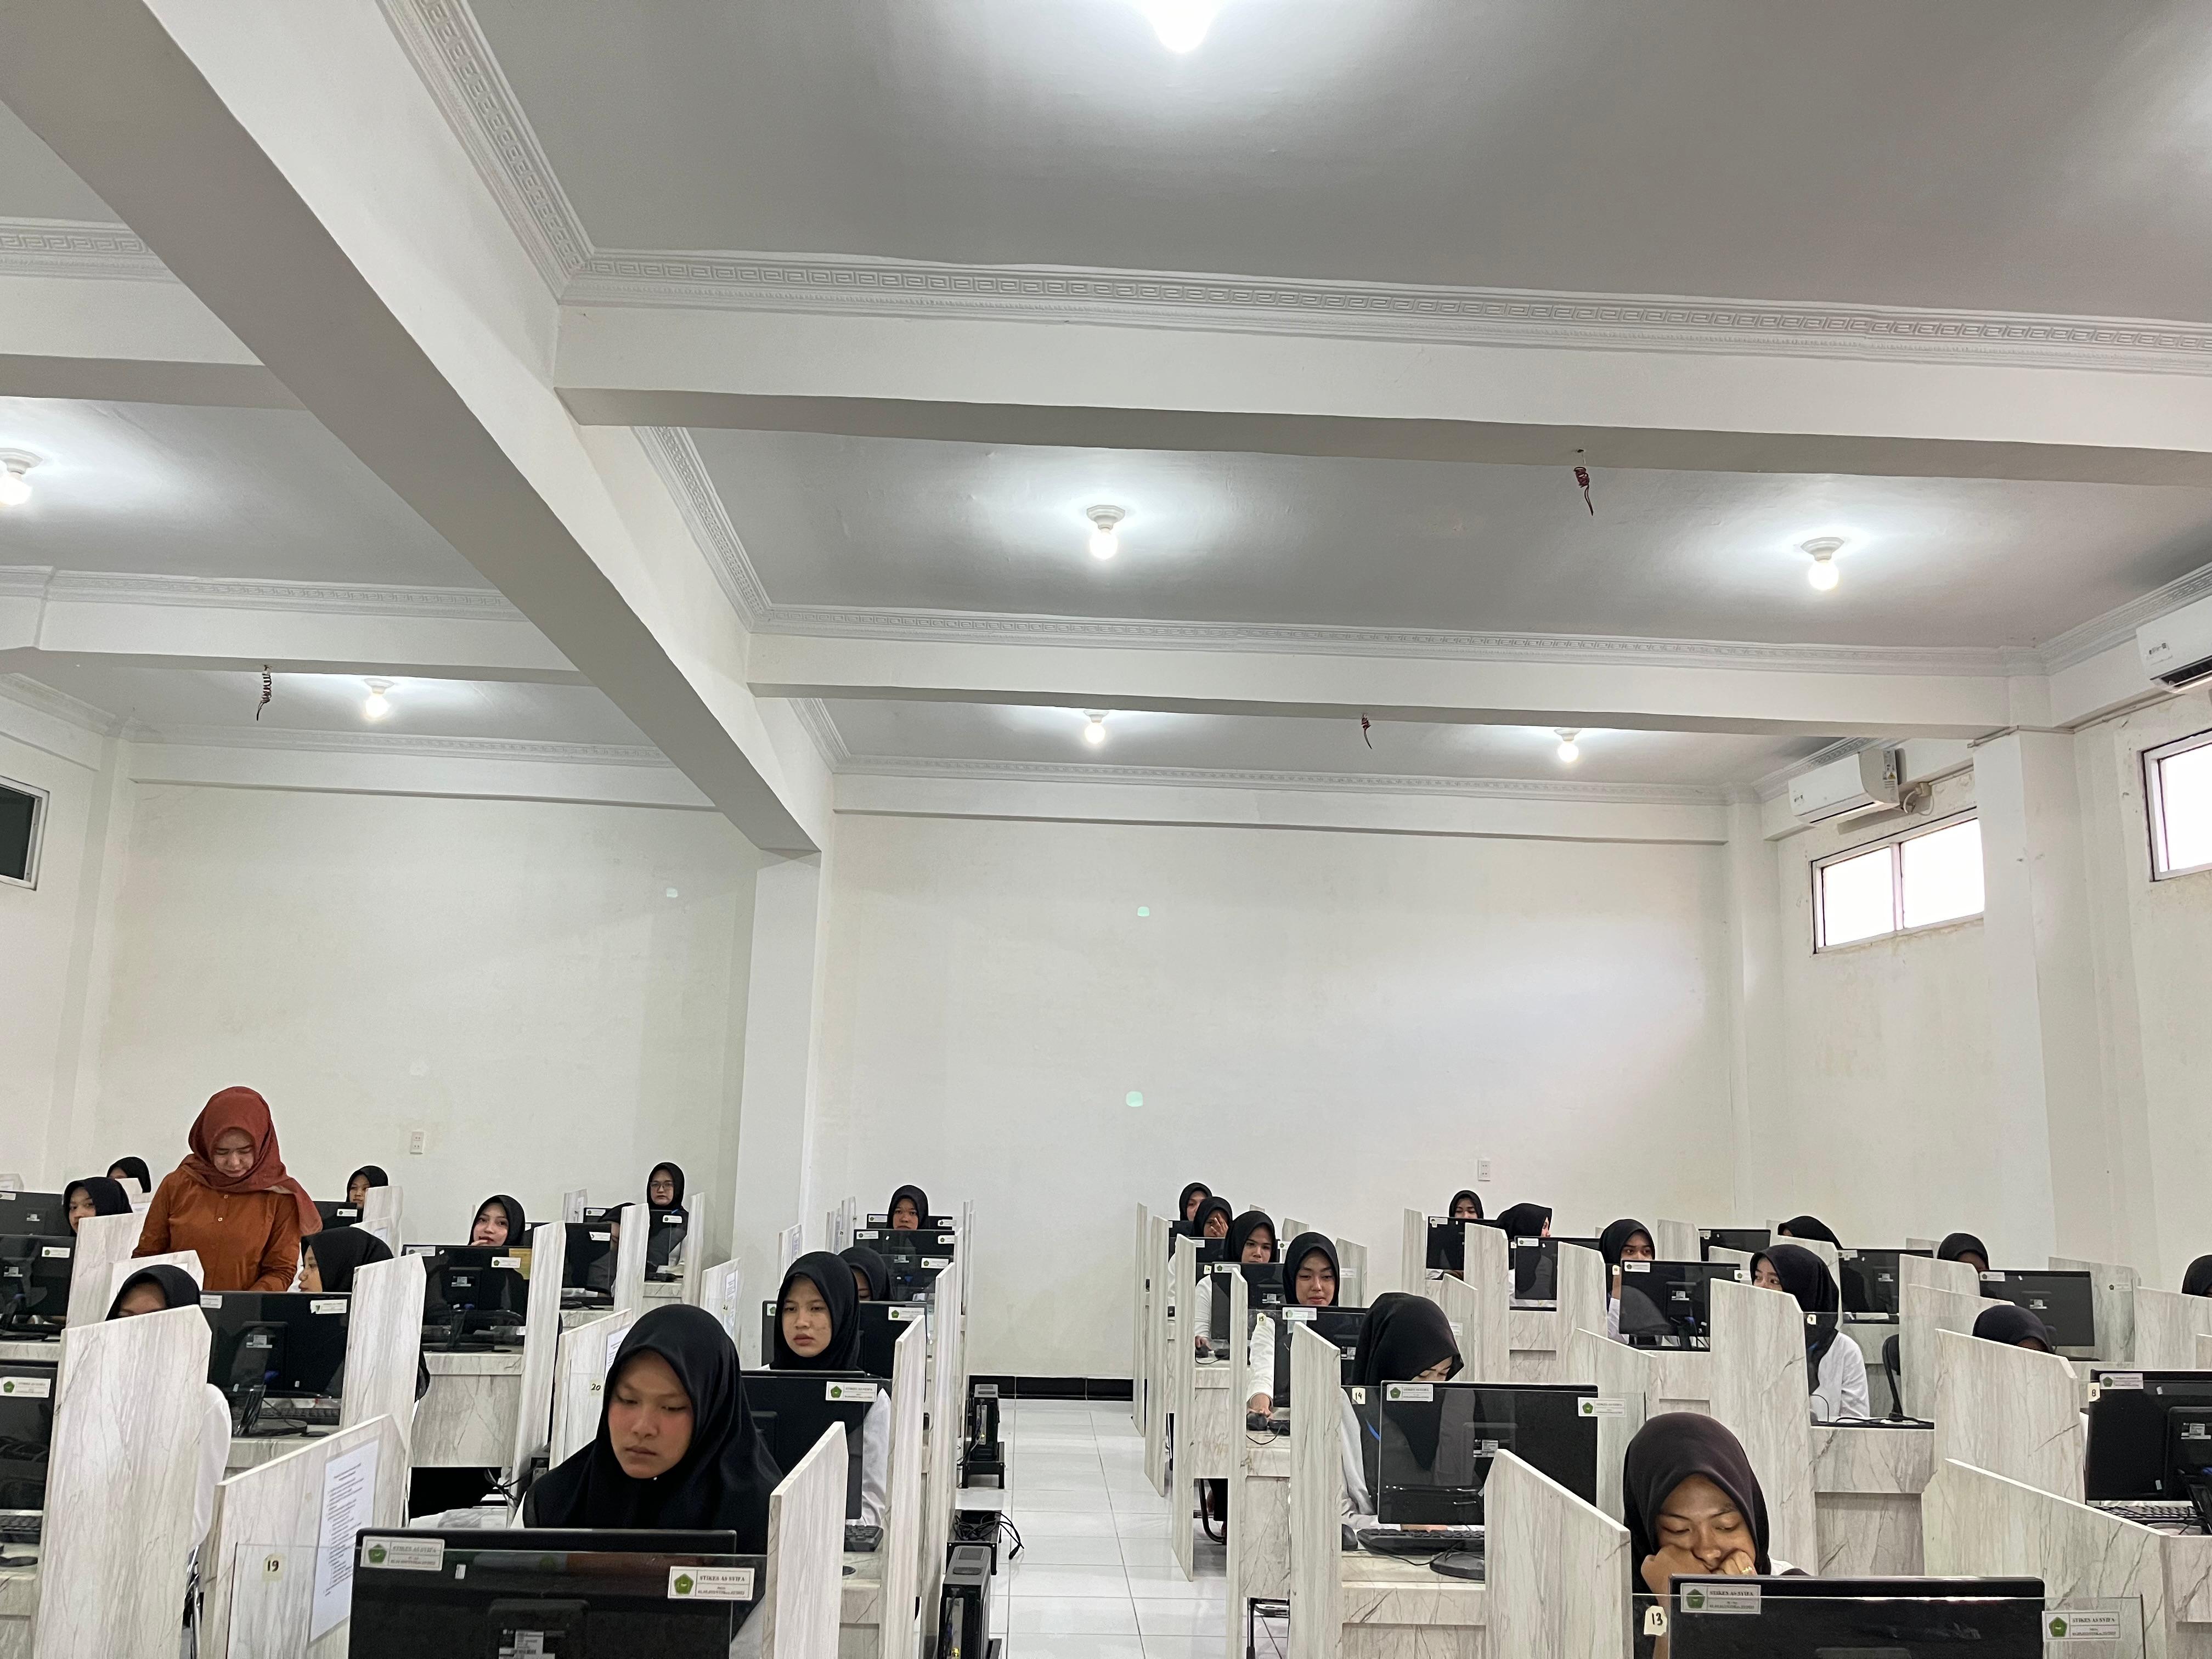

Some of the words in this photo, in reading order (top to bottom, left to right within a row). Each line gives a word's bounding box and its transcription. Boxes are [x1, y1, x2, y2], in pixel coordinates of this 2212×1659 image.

[1355, 1392, 1362, 1401] 14
[267, 1560, 279, 1572] 19
[1651, 1612, 1663, 1626] 13
